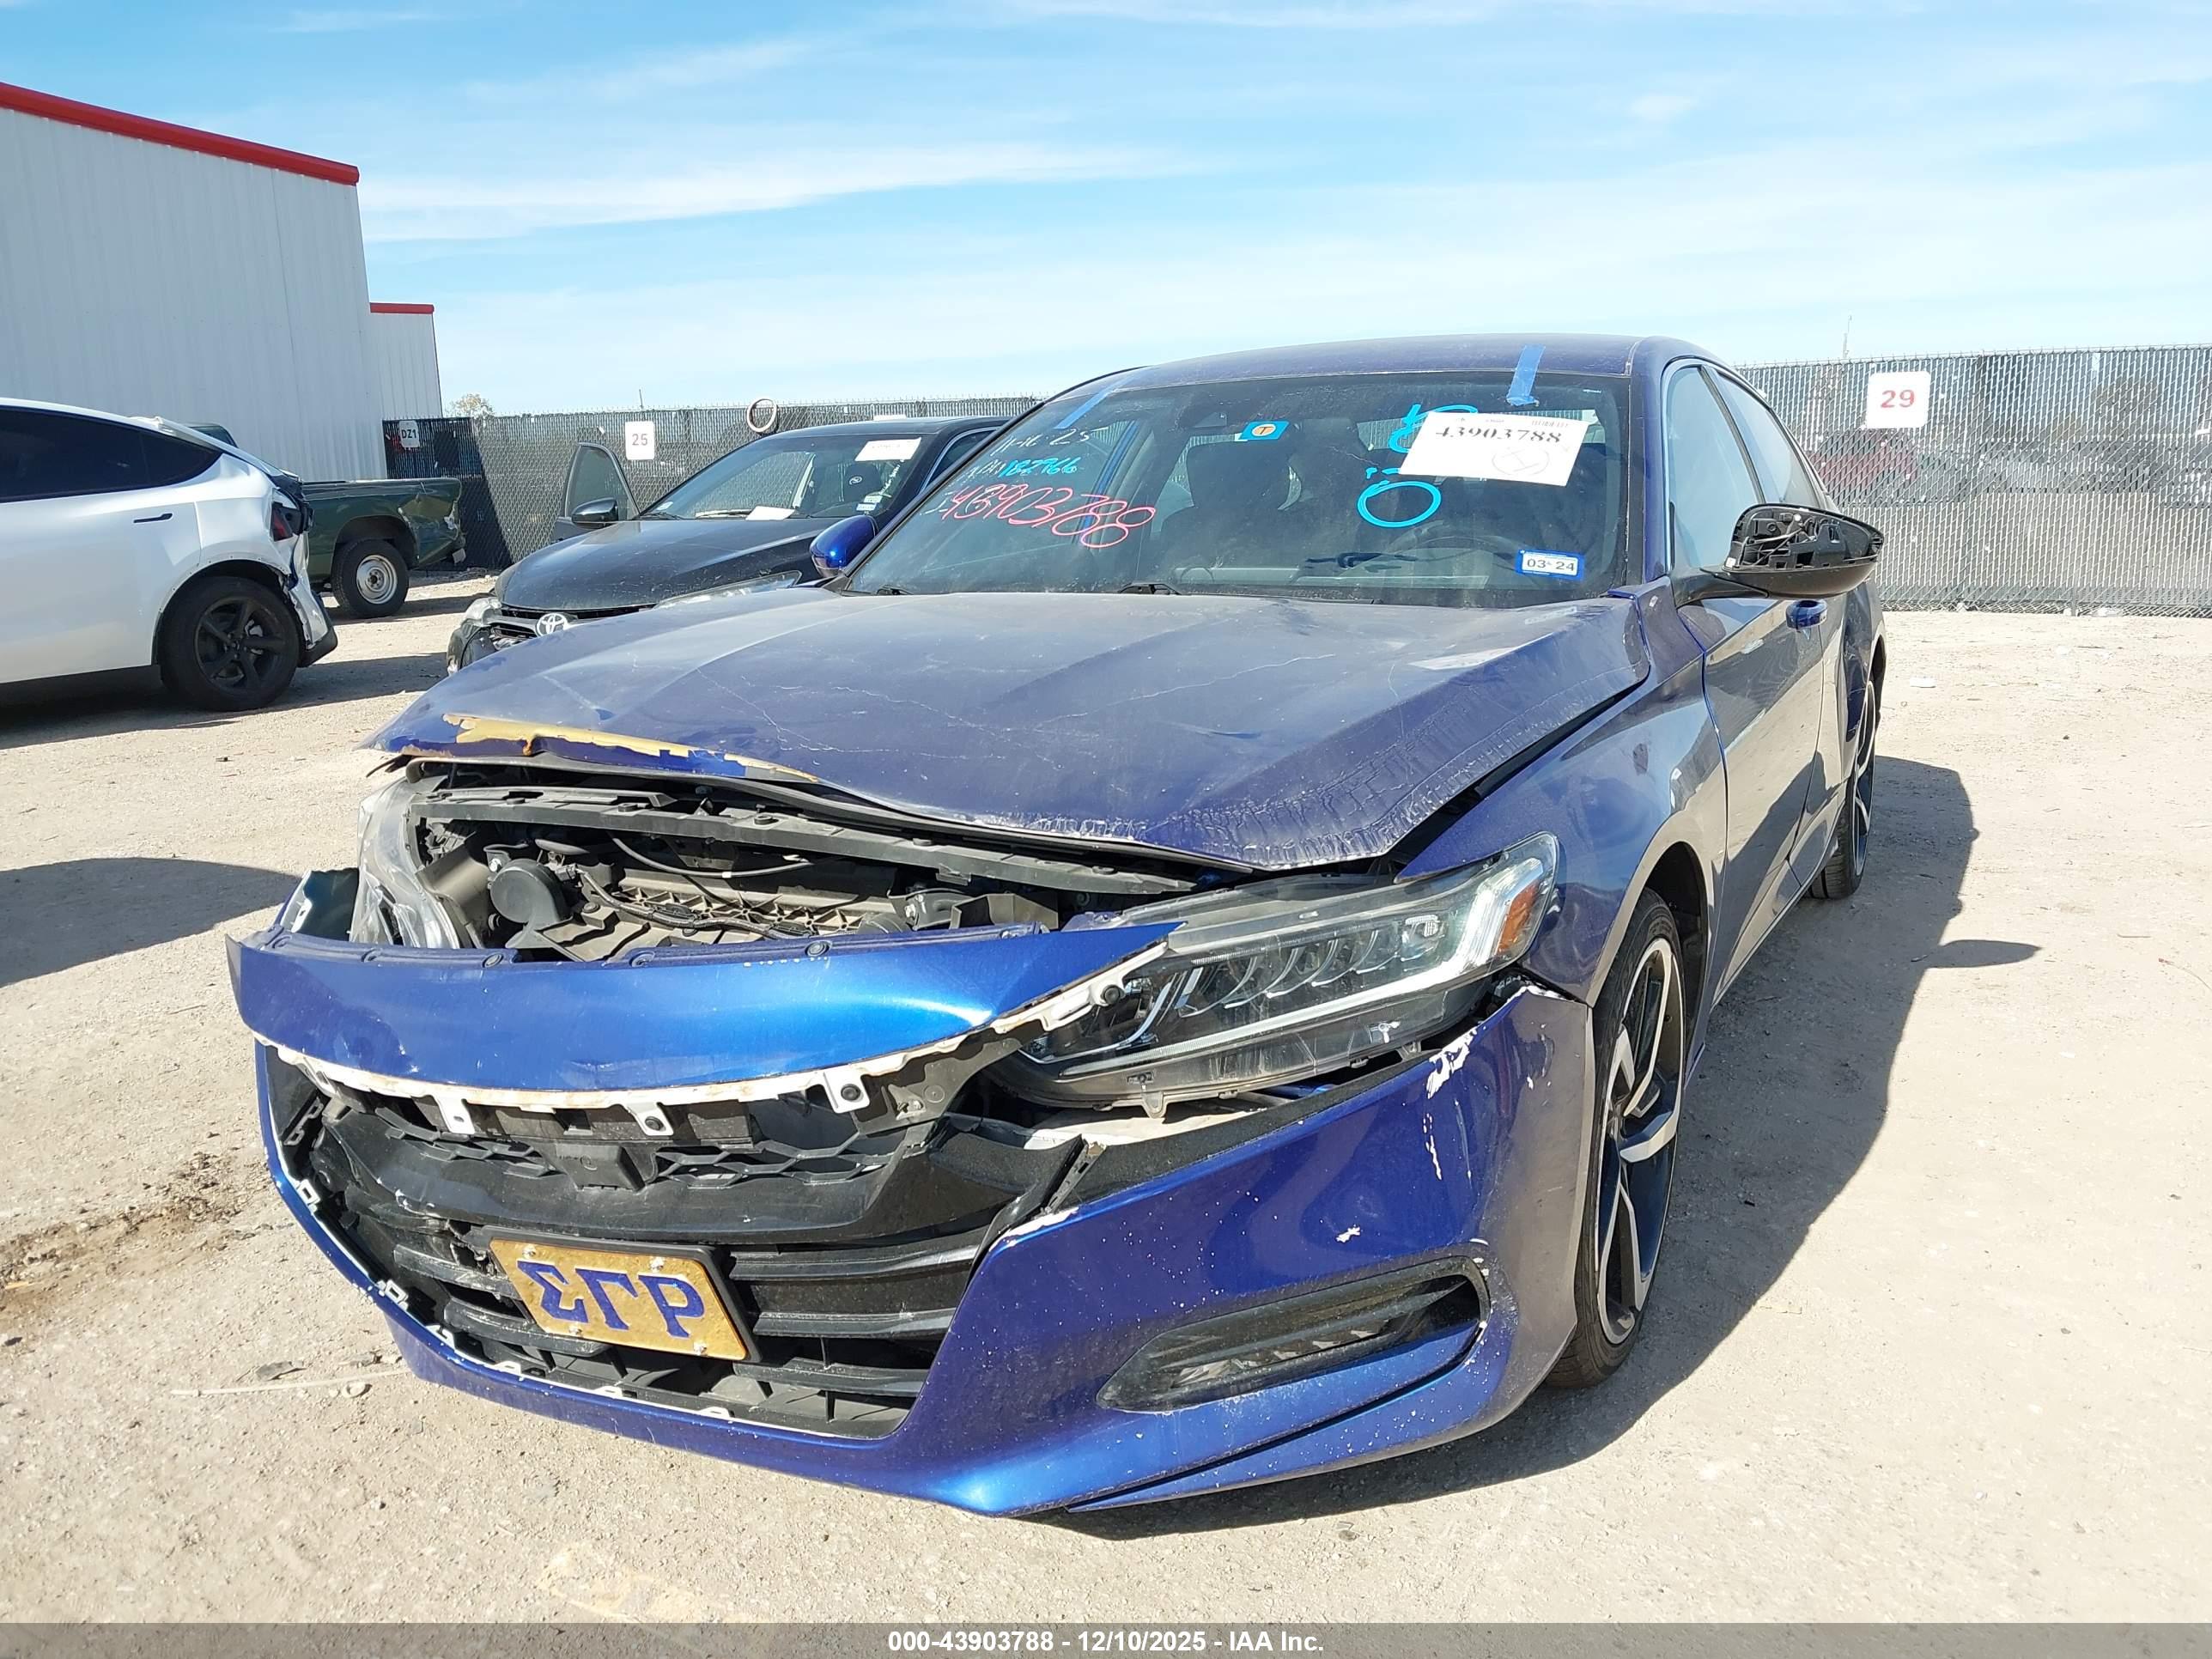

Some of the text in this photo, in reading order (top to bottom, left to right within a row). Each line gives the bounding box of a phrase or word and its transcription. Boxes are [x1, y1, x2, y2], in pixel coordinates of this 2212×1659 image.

[1881, 389, 1915, 408] 29
[401, 428, 417, 439] DZ1
[632, 433, 648, 446] 25
[1436, 426, 1562, 443] 43903788
